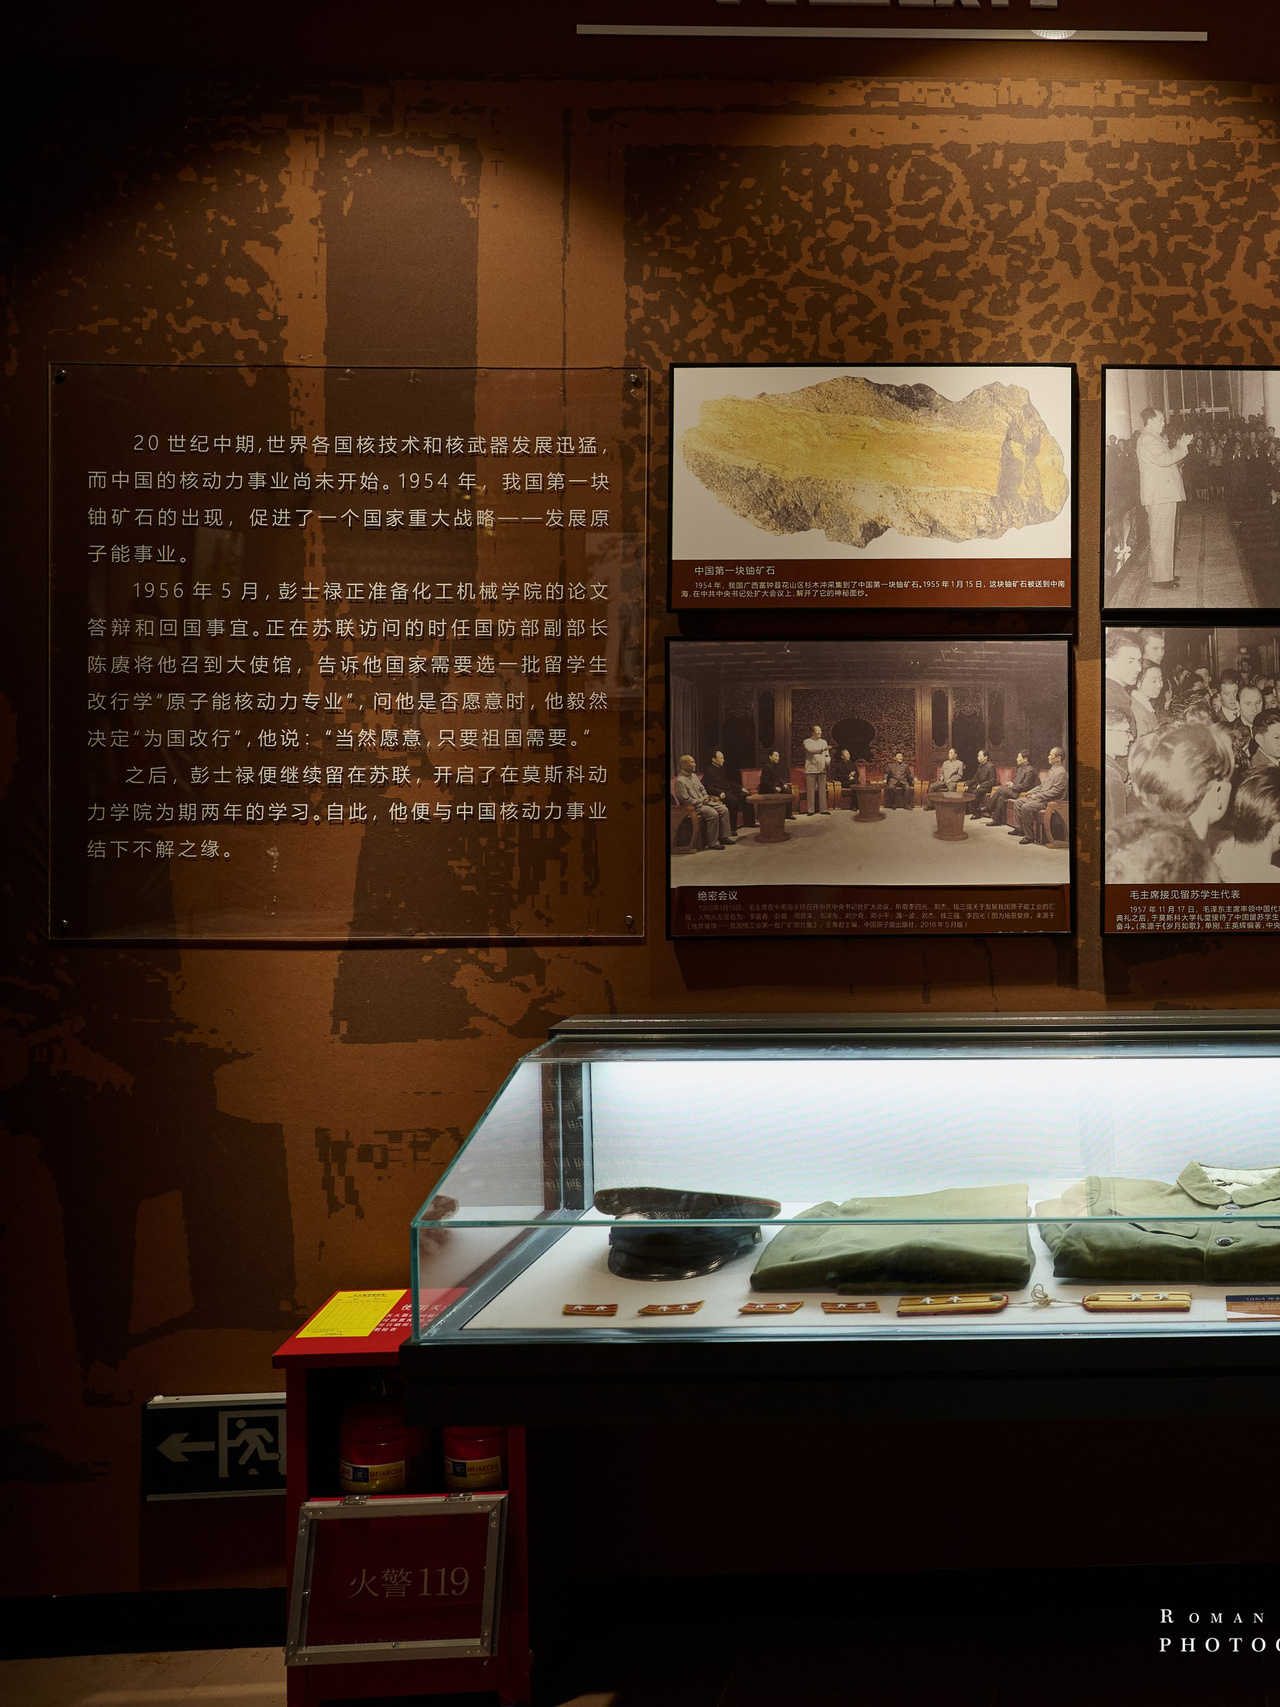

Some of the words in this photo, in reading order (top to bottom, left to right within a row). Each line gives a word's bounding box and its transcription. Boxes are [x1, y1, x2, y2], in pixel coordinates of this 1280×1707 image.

[695, 566, 775, 575] 中国第一块铀矿石
[698, 891, 737, 901] 绝密会议
[1130, 890, 1240, 899] 毛主席接见留苏学生代表
